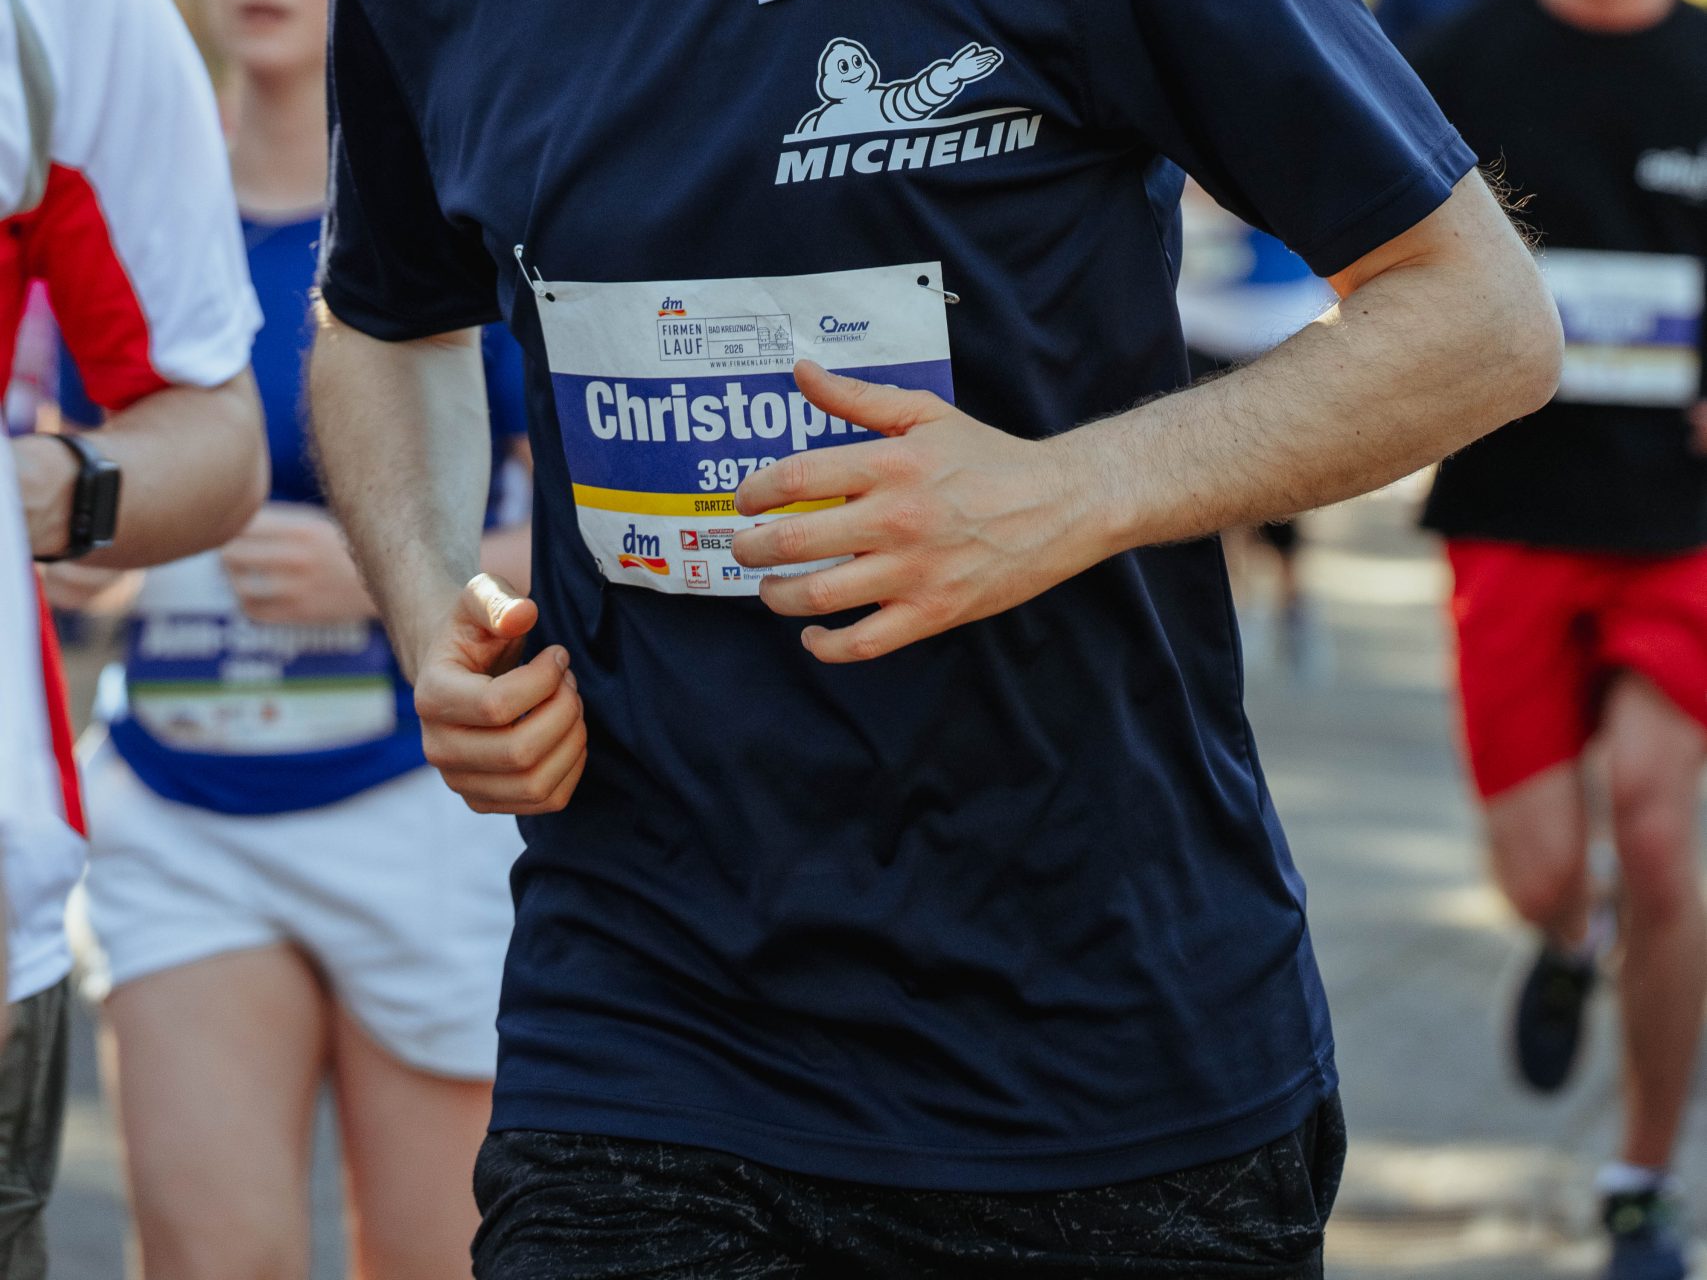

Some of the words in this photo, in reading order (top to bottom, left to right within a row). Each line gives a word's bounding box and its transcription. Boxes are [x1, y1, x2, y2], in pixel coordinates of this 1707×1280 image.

[774, 114, 1043, 185] MICHELIN
[662, 296, 683, 310] dm
[662, 323, 702, 336] FIRMEN
[708, 325, 720, 334] BAD
[721, 324, 756, 334] KREUZNACH
[664, 338, 703, 356] LAUF
[724, 343, 744, 355] 2026
[623, 524, 661, 558] dm
